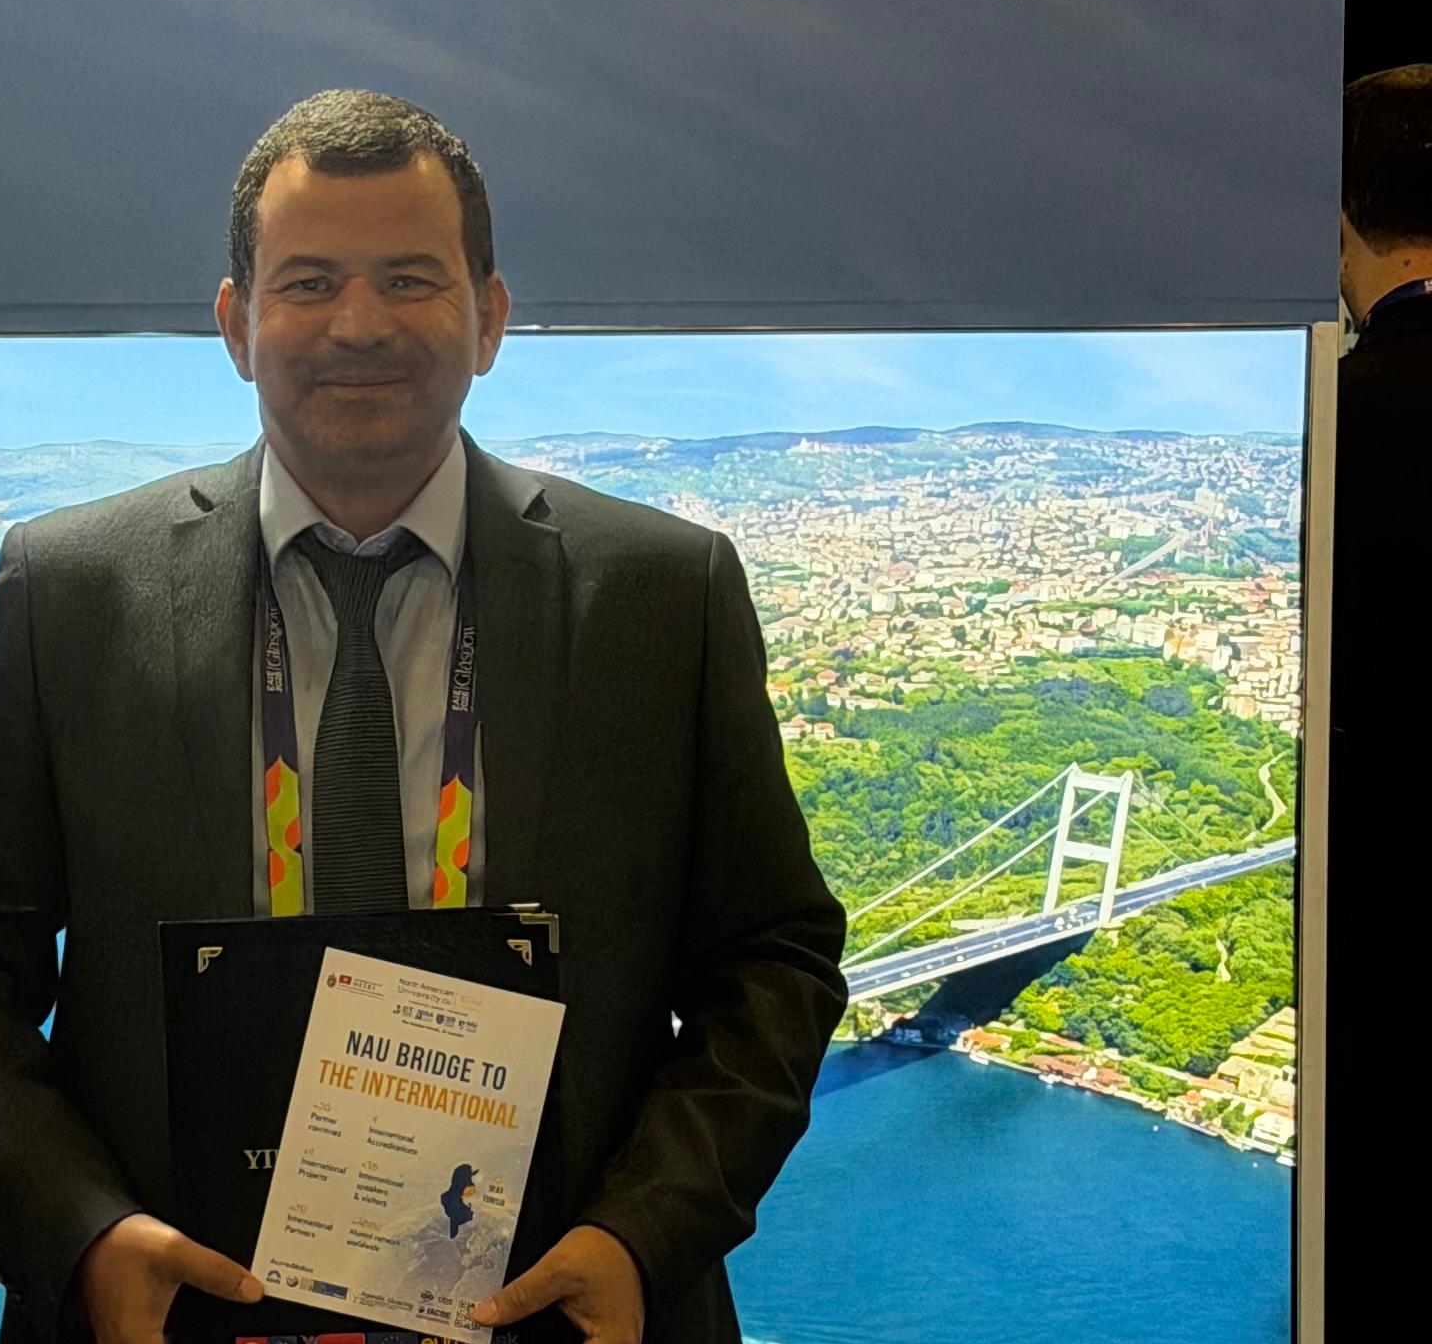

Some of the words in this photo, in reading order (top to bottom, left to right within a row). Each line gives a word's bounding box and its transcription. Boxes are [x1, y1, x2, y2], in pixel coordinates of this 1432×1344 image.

[344, 1029, 391, 1063] NAU
[394, 1041, 475, 1083] BRIDGE
[477, 1061, 508, 1091] TO
[315, 1058, 358, 1090] THE
[360, 1068, 522, 1130] INTERNATIONAL
